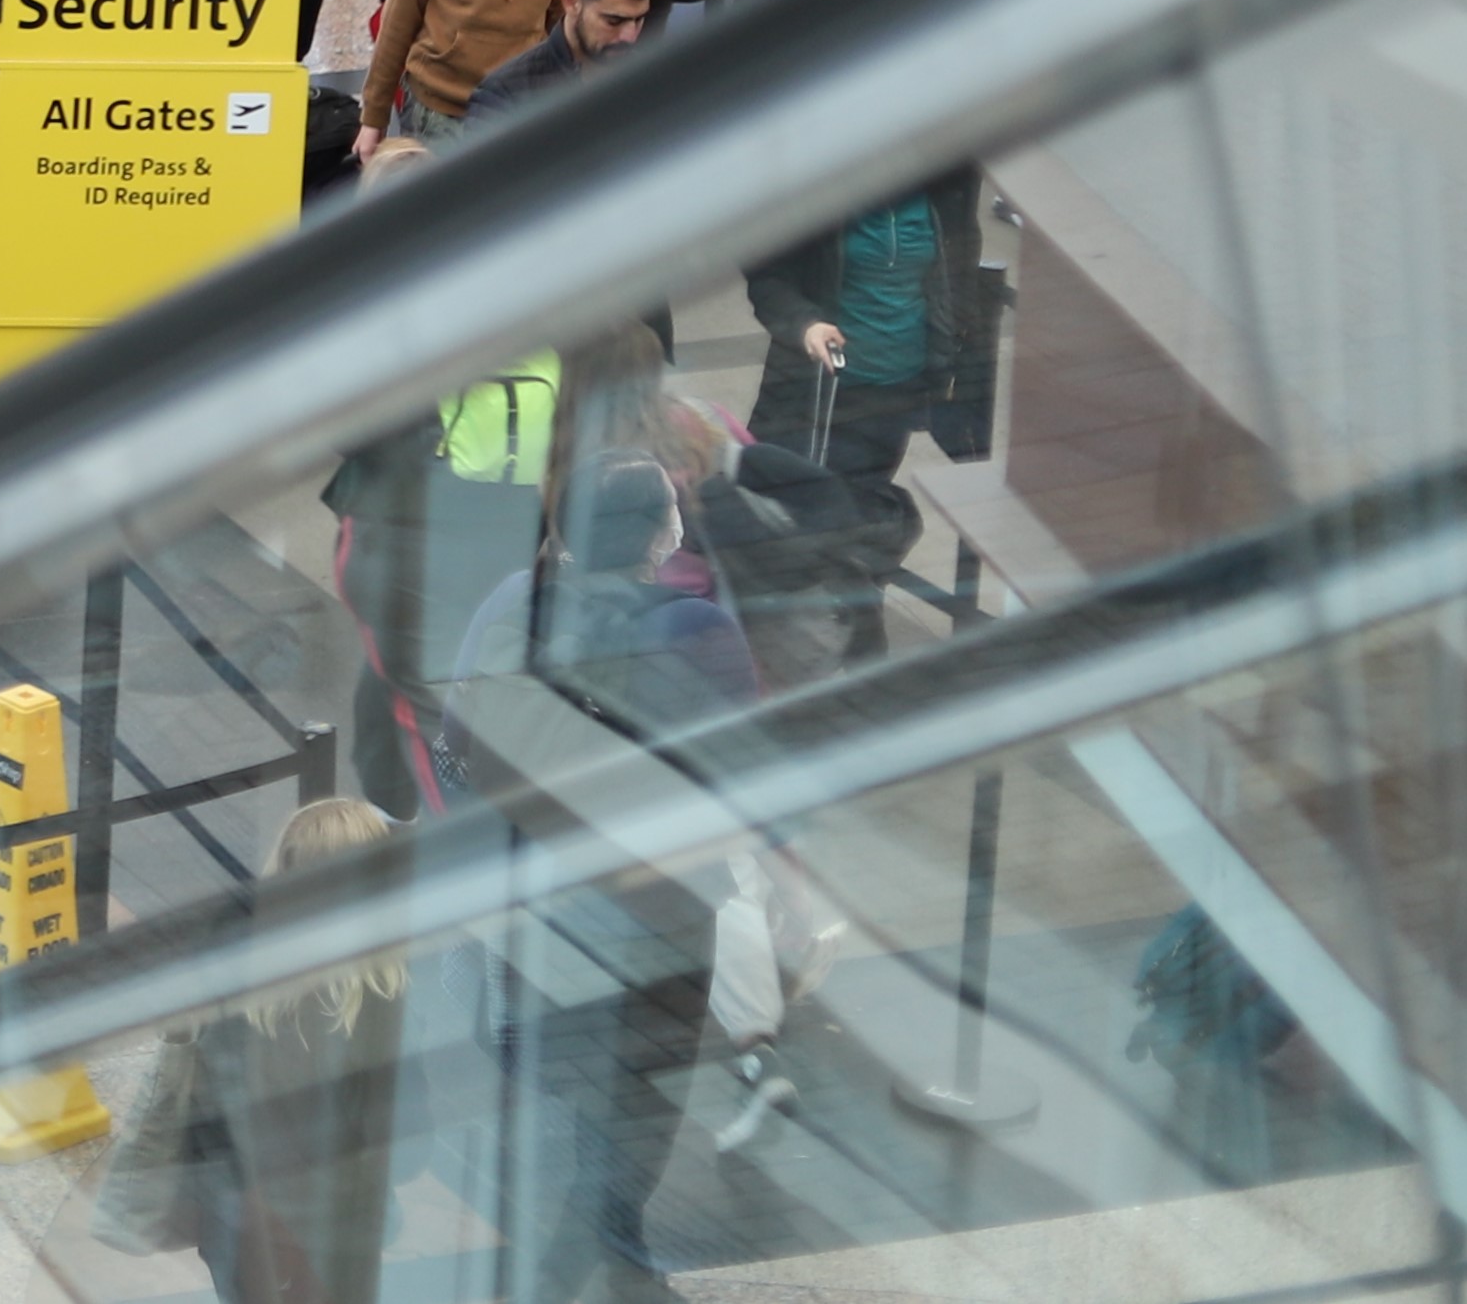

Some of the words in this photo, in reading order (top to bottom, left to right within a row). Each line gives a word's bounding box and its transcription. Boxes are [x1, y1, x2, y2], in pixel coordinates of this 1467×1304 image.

[41, 97, 92, 130] All
[105, 99, 215, 131] Gates
[37, 157, 134, 180] Boarding
[141, 158, 186, 176] Pass
[194, 157, 211, 175] &
[85, 188, 107, 205] ID
[115, 187, 210, 210] Required
[28, 841, 65, 868] CAUTION
[33, 913, 62, 938] WET
